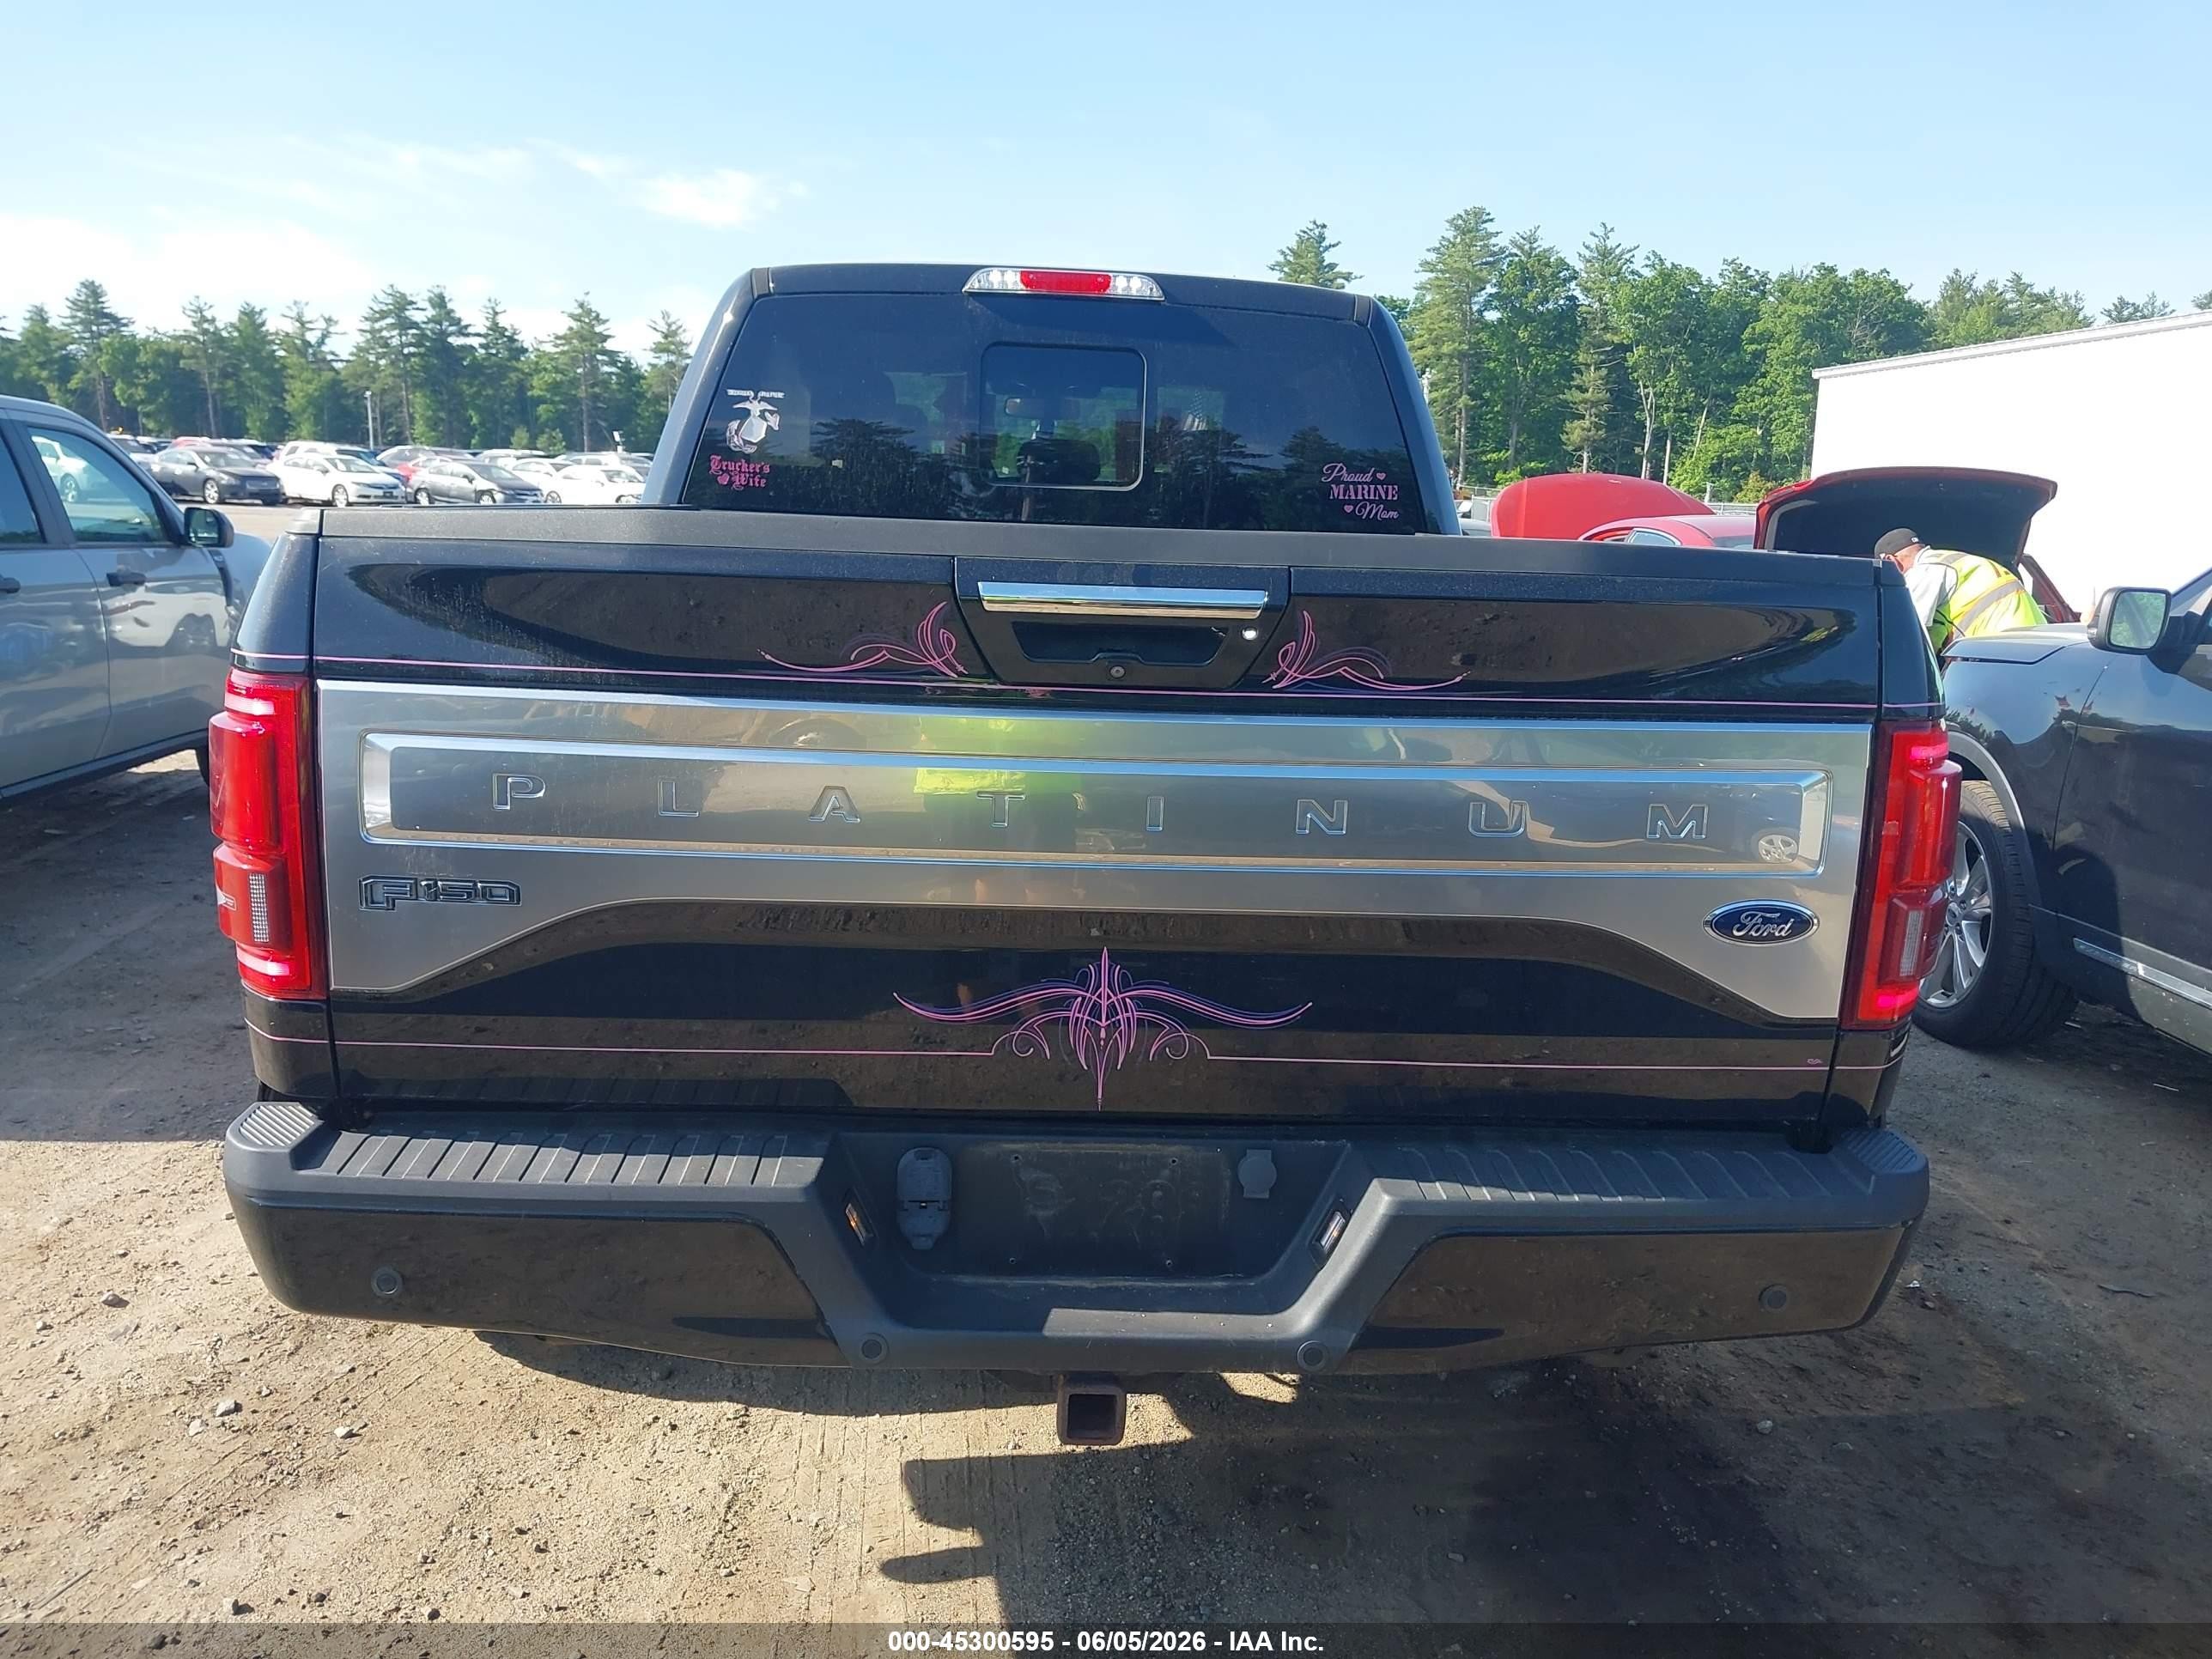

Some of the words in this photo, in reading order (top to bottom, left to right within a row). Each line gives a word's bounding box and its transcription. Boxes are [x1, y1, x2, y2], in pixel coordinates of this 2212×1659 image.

[709, 455, 770, 475] Trucker's
[1322, 463, 1375, 483] Proud
[731, 473, 767, 490] Wife
[1329, 484, 1399, 501] MARINE
[1355, 501, 1399, 520] Mom
[491, 772, 1711, 841] PLATINUM
[1732, 911, 1795, 937] Ford
